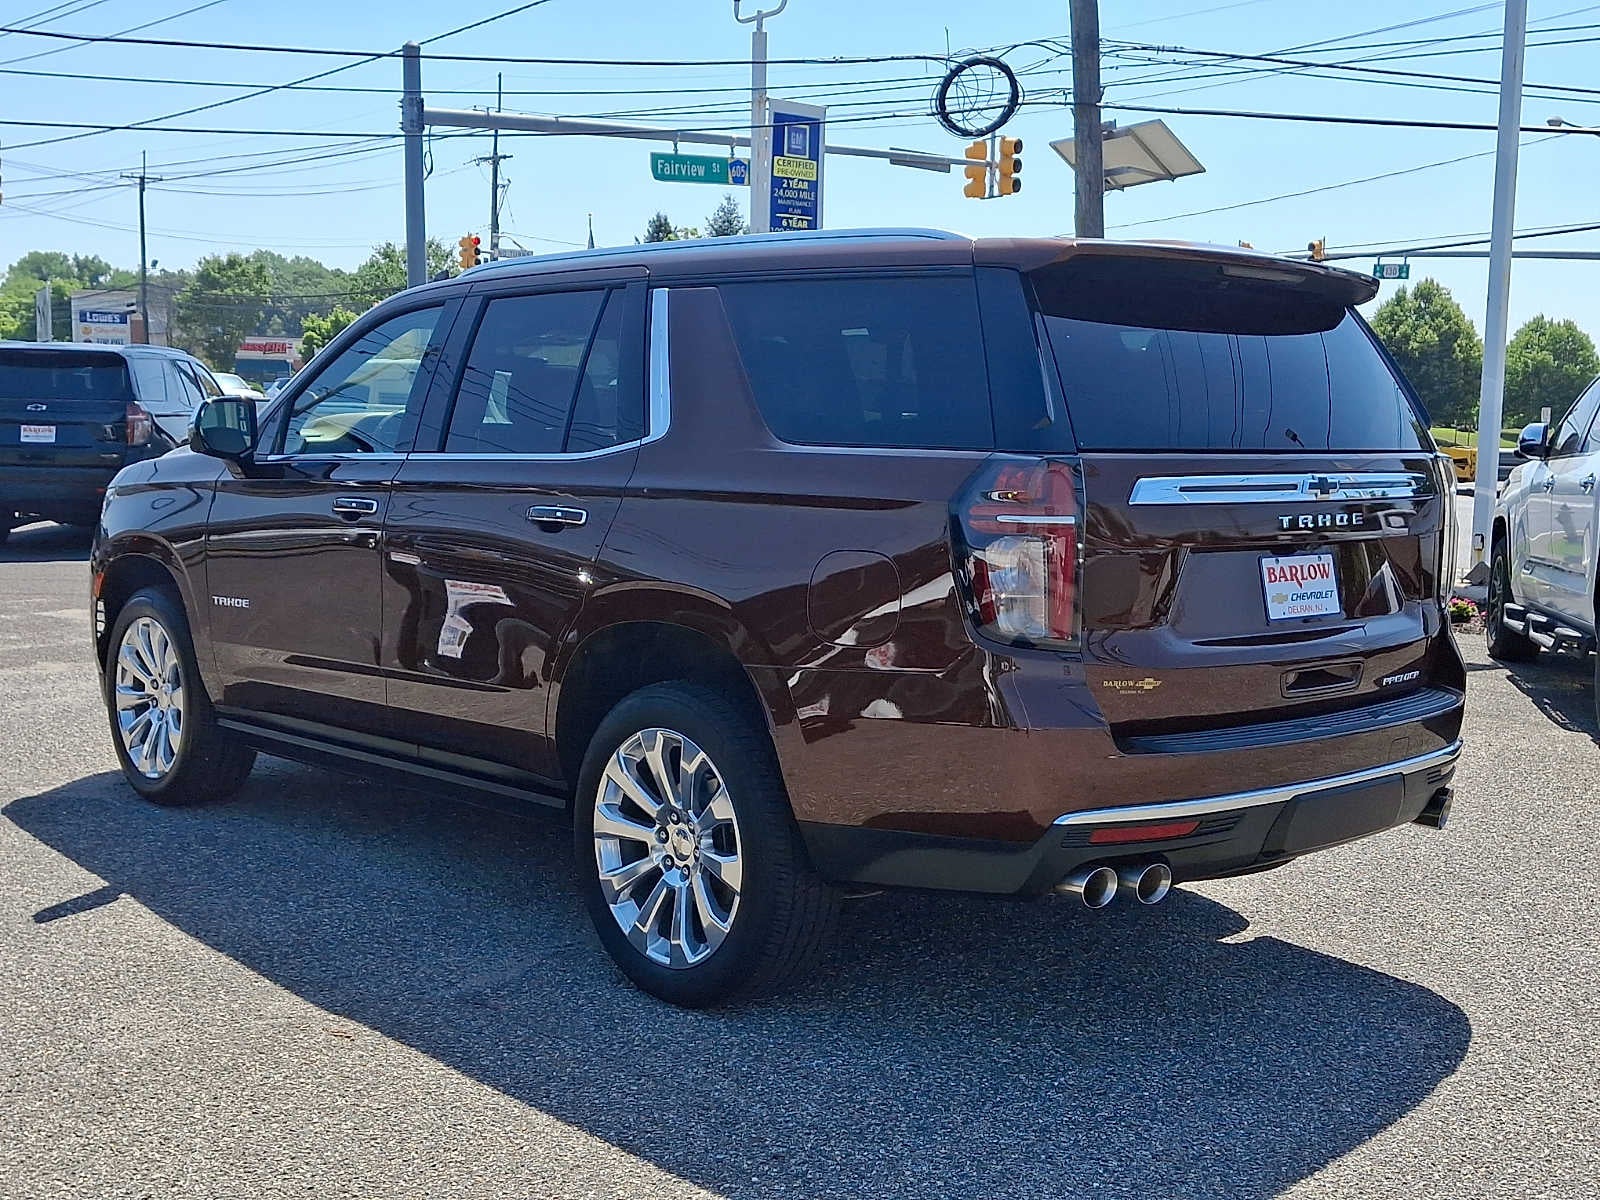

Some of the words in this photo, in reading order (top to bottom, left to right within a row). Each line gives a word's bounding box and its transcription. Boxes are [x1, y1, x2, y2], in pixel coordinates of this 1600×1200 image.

[657, 160, 705, 177] Fairview
[712, 162, 721, 173] St
[776, 158, 815, 170] CERTIFIED
[731, 165, 746, 178] 605
[776, 167, 814, 178] PRE-OWNED
[782, 179, 788, 188] 2
[788, 180, 808, 190] YEAR
[773, 188, 798, 199] 24,000
[799, 191, 816, 201] MILE
[781, 218, 787, 227] 6
[788, 219, 808, 229] YEAR
[1278, 512, 1365, 529] TAHOE
[1267, 563, 1330, 589] BARLOW
[211, 595, 250, 609] TAHOE
[1291, 590, 1334, 602] CHEVROLET
[1103, 680, 1134, 690] BARLOW
